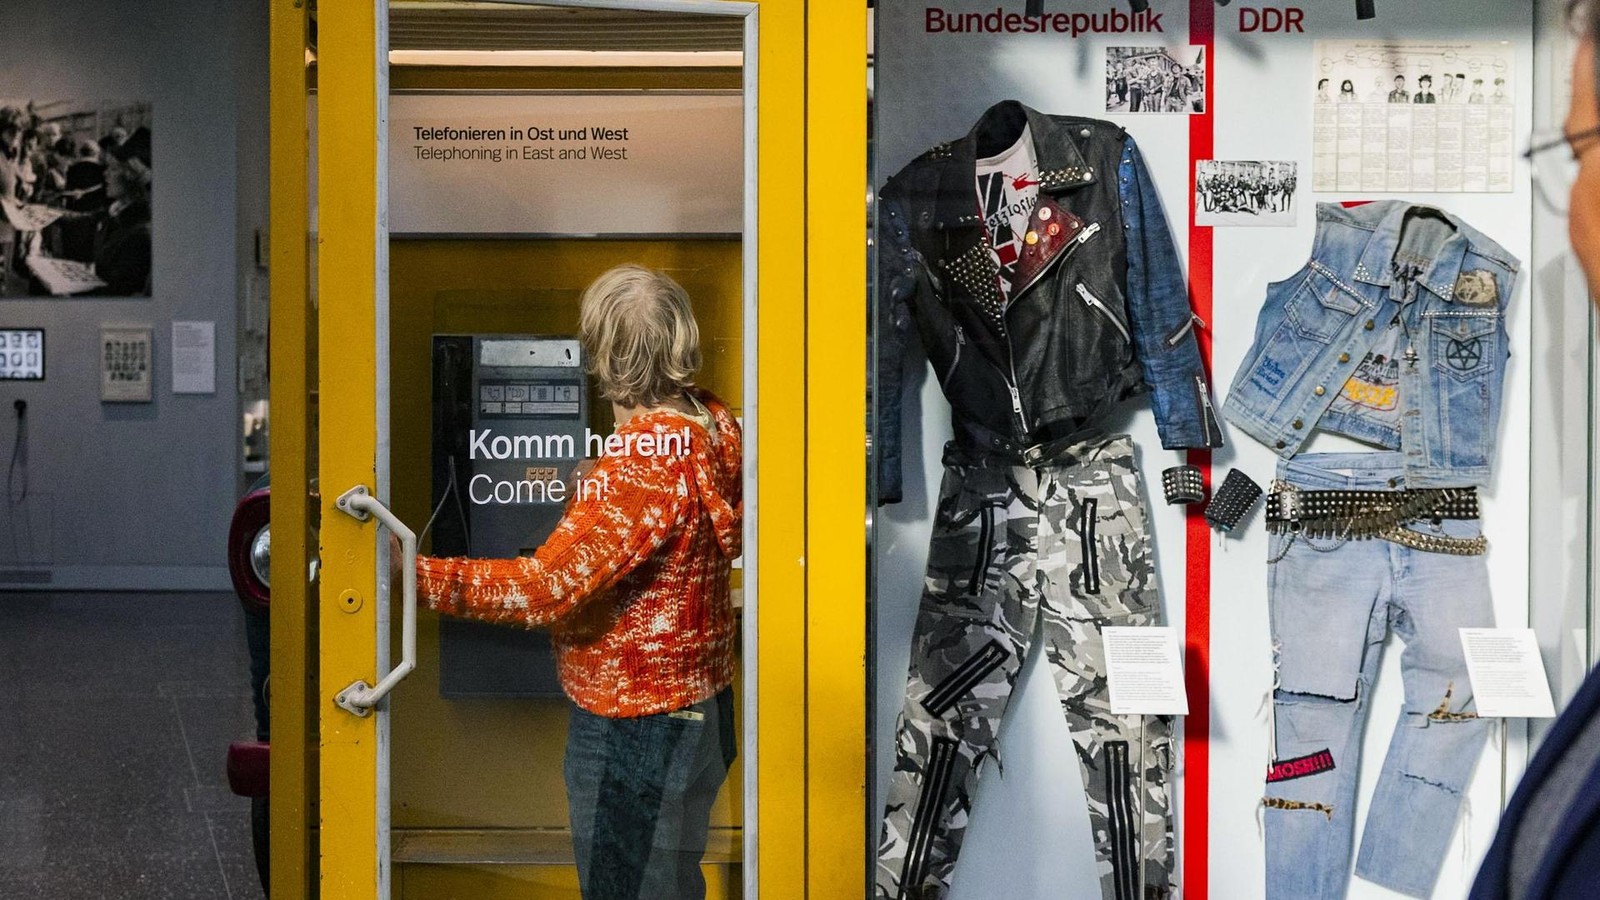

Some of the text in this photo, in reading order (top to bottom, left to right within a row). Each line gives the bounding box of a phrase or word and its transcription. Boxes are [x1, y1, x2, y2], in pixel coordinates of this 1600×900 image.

[925, 7, 1164, 38] Bundesrepublik
[1238, 7, 1305, 33] DDR
[413, 126, 629, 141] Telefonieren in Ost und West
[413, 145, 628, 163] Telephoning in East and West
[469, 426, 692, 460] Komm herein!
[468, 471, 609, 506] Come in!
